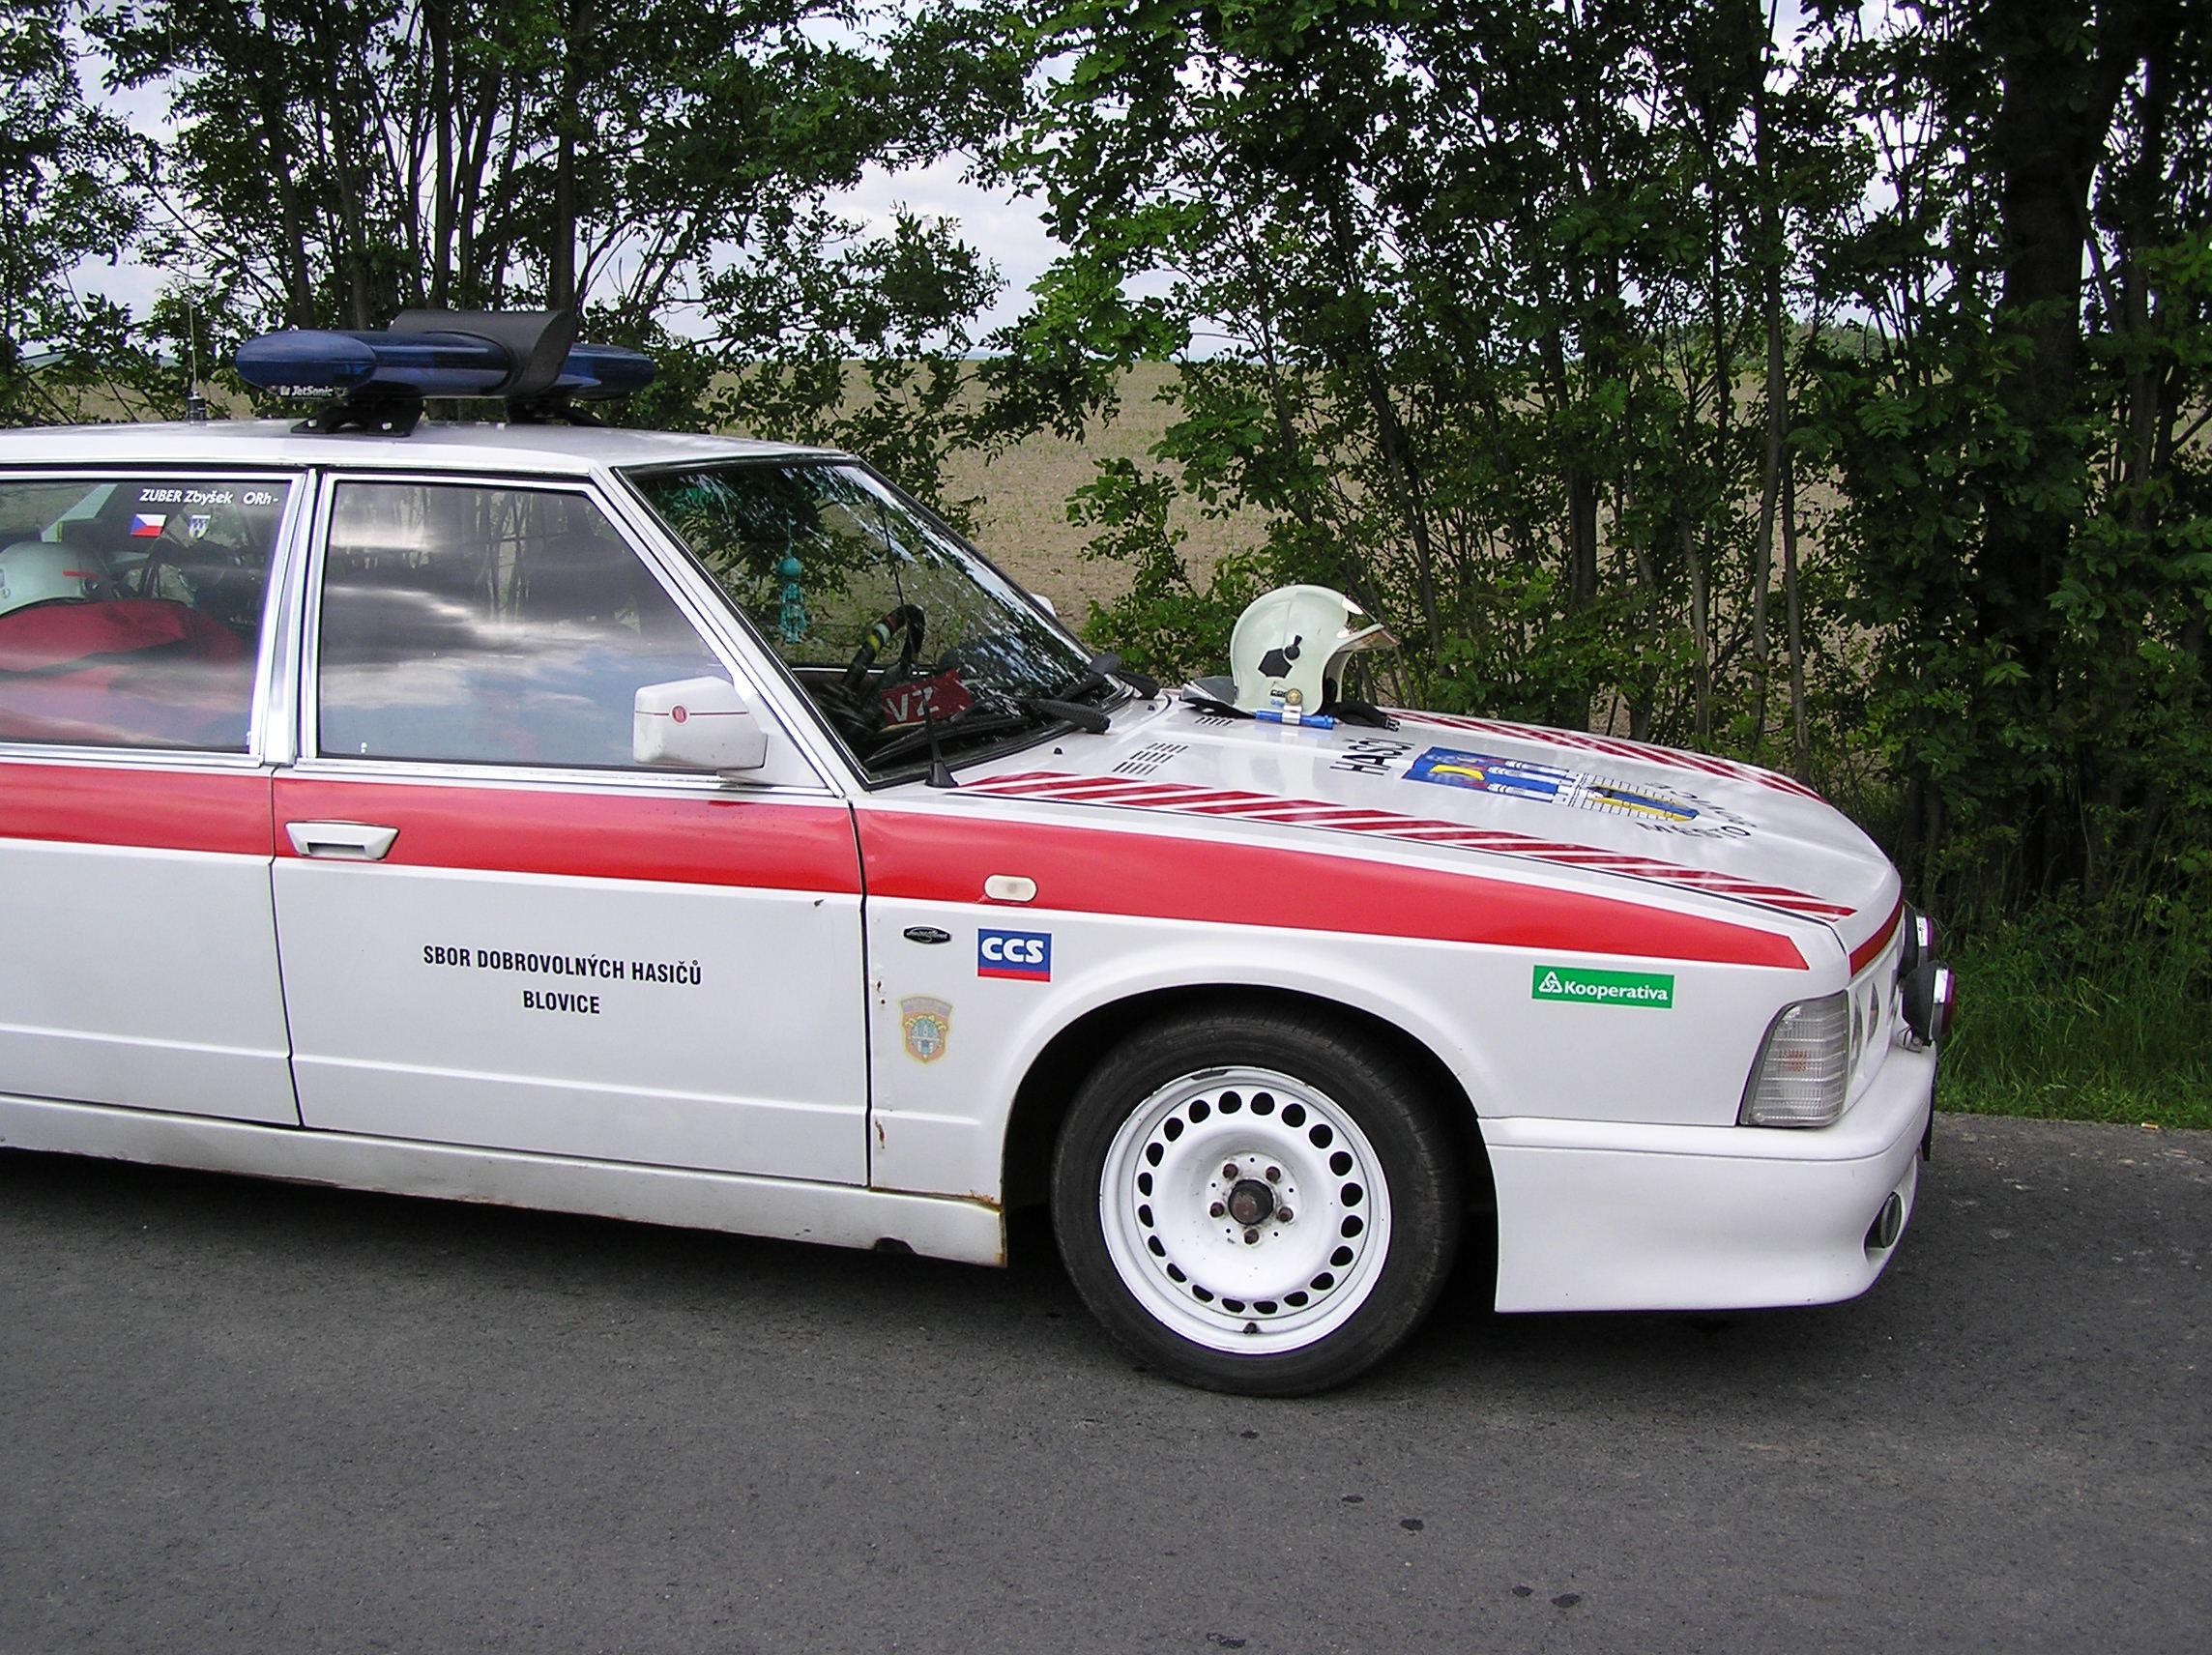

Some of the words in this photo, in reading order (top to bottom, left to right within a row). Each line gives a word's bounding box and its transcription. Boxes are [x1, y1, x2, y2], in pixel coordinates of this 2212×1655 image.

[139, 488, 182, 503] ZUBER
[184, 490, 234, 506] Zbyšek
[981, 937, 1044, 964] CCS
[423, 945, 471, 967] SBOR
[478, 950, 625, 979] DOBROVOLNÝCH
[631, 960, 702, 985] HASIČŮ
[523, 990, 600, 1014] BLOVICE
[1564, 981, 1669, 1001] Kooperativa
